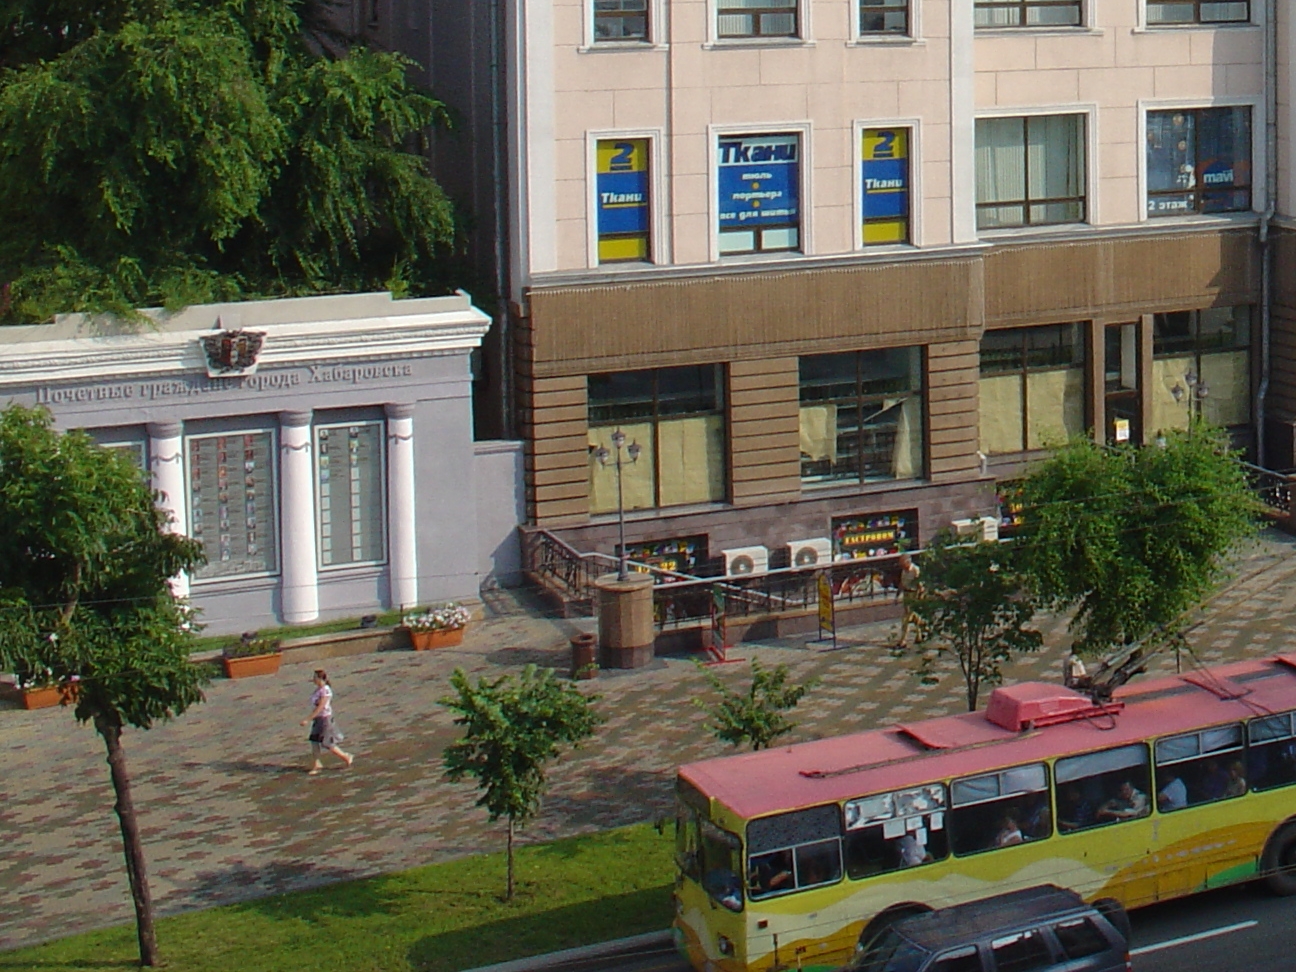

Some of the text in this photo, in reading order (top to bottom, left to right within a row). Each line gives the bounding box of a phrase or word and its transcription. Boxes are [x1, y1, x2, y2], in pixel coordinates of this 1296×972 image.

[874, 130, 895, 152] 2
[611, 142, 634, 163] 2
[719, 141, 796, 163] Ткани
[865, 178, 903, 189] Ткани
[1203, 169, 1233, 183] mavi
[601, 192, 642, 203] Ткани
[1148, 200, 1188, 211] 2 этаж
[35, 385, 135, 406] Почетные
[240, 371, 302, 392] города
[307, 362, 412, 384] Хабаровска
